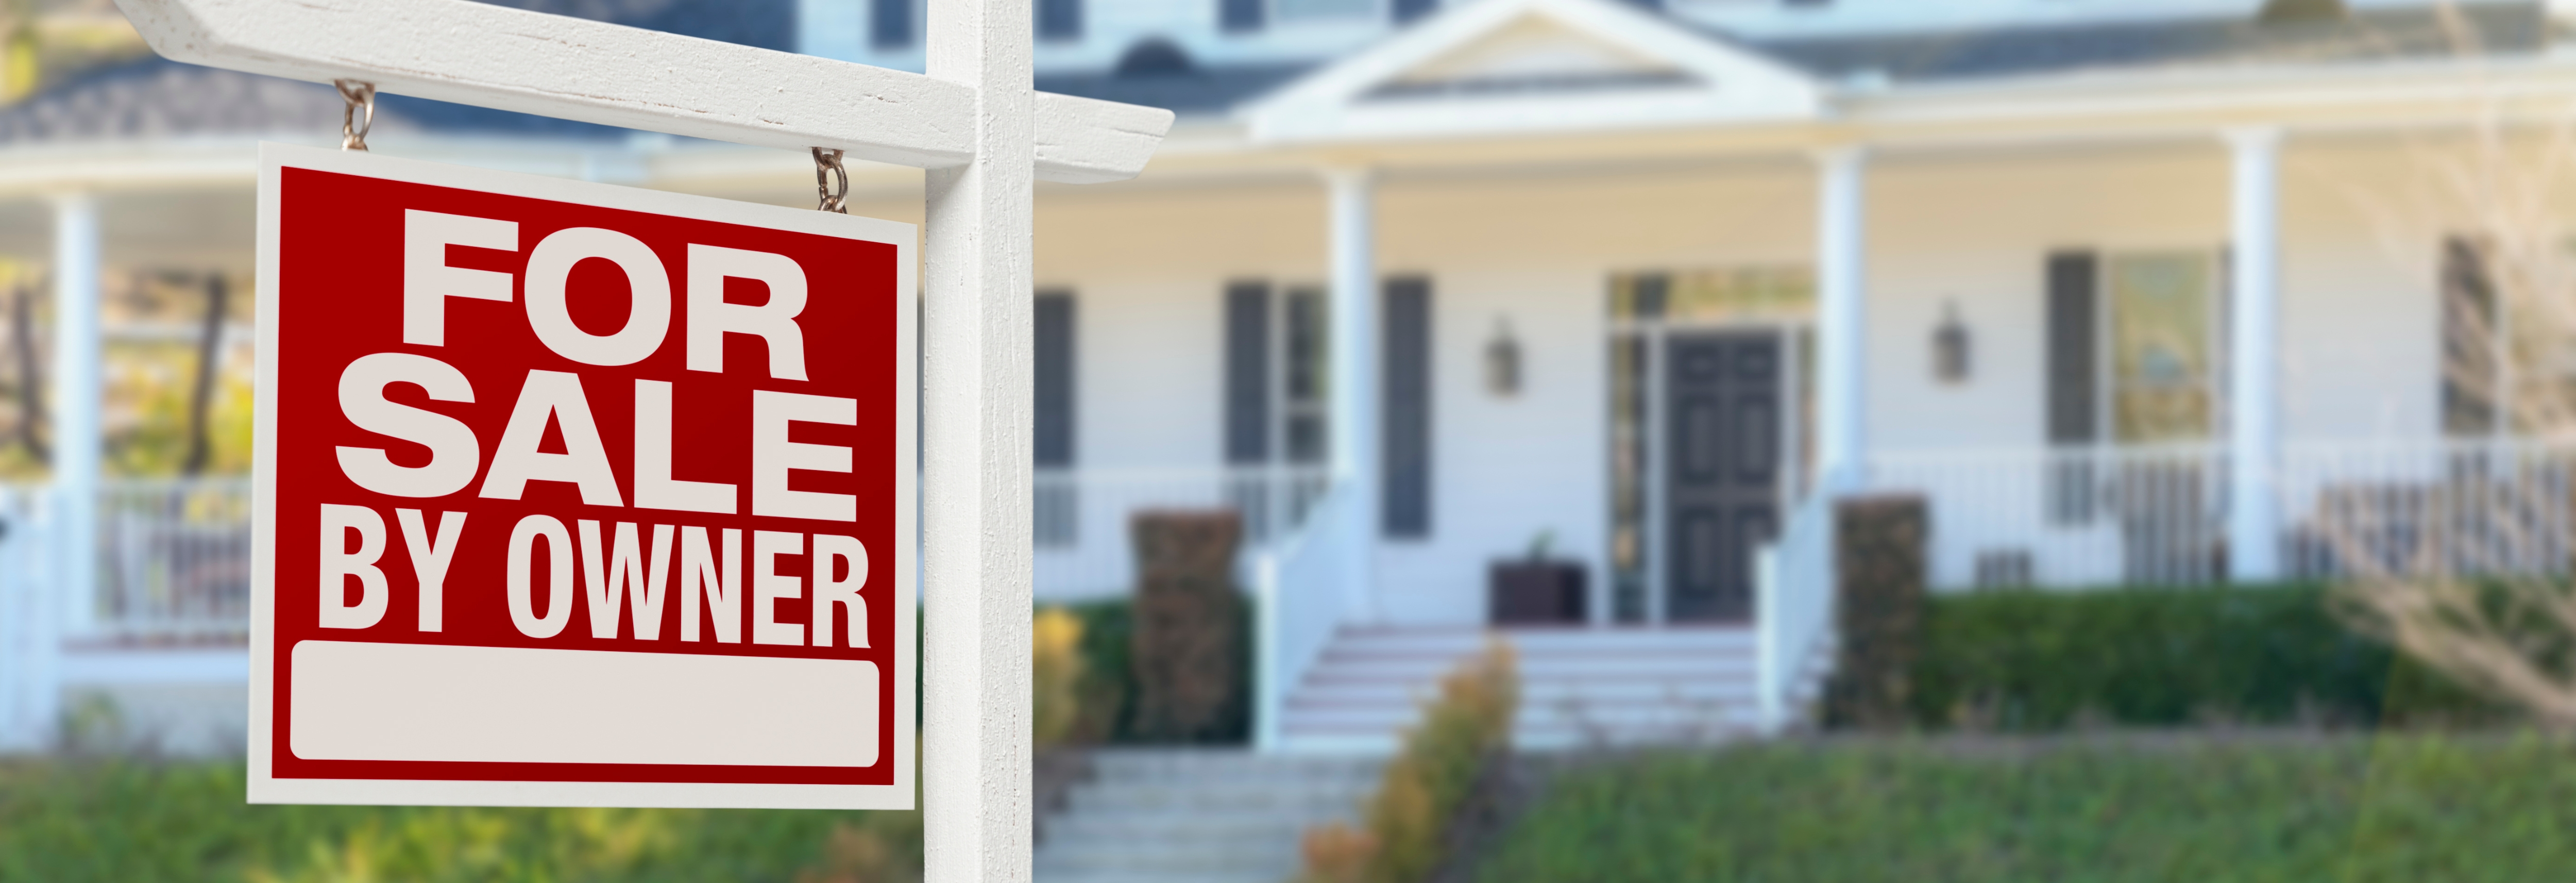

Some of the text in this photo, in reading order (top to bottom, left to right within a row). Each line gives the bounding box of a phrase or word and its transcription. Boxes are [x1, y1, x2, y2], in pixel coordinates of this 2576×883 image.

[403, 209, 809, 381] FOR
[336, 353, 857, 522] SALE
[319, 504, 871, 648] BY OWNER
